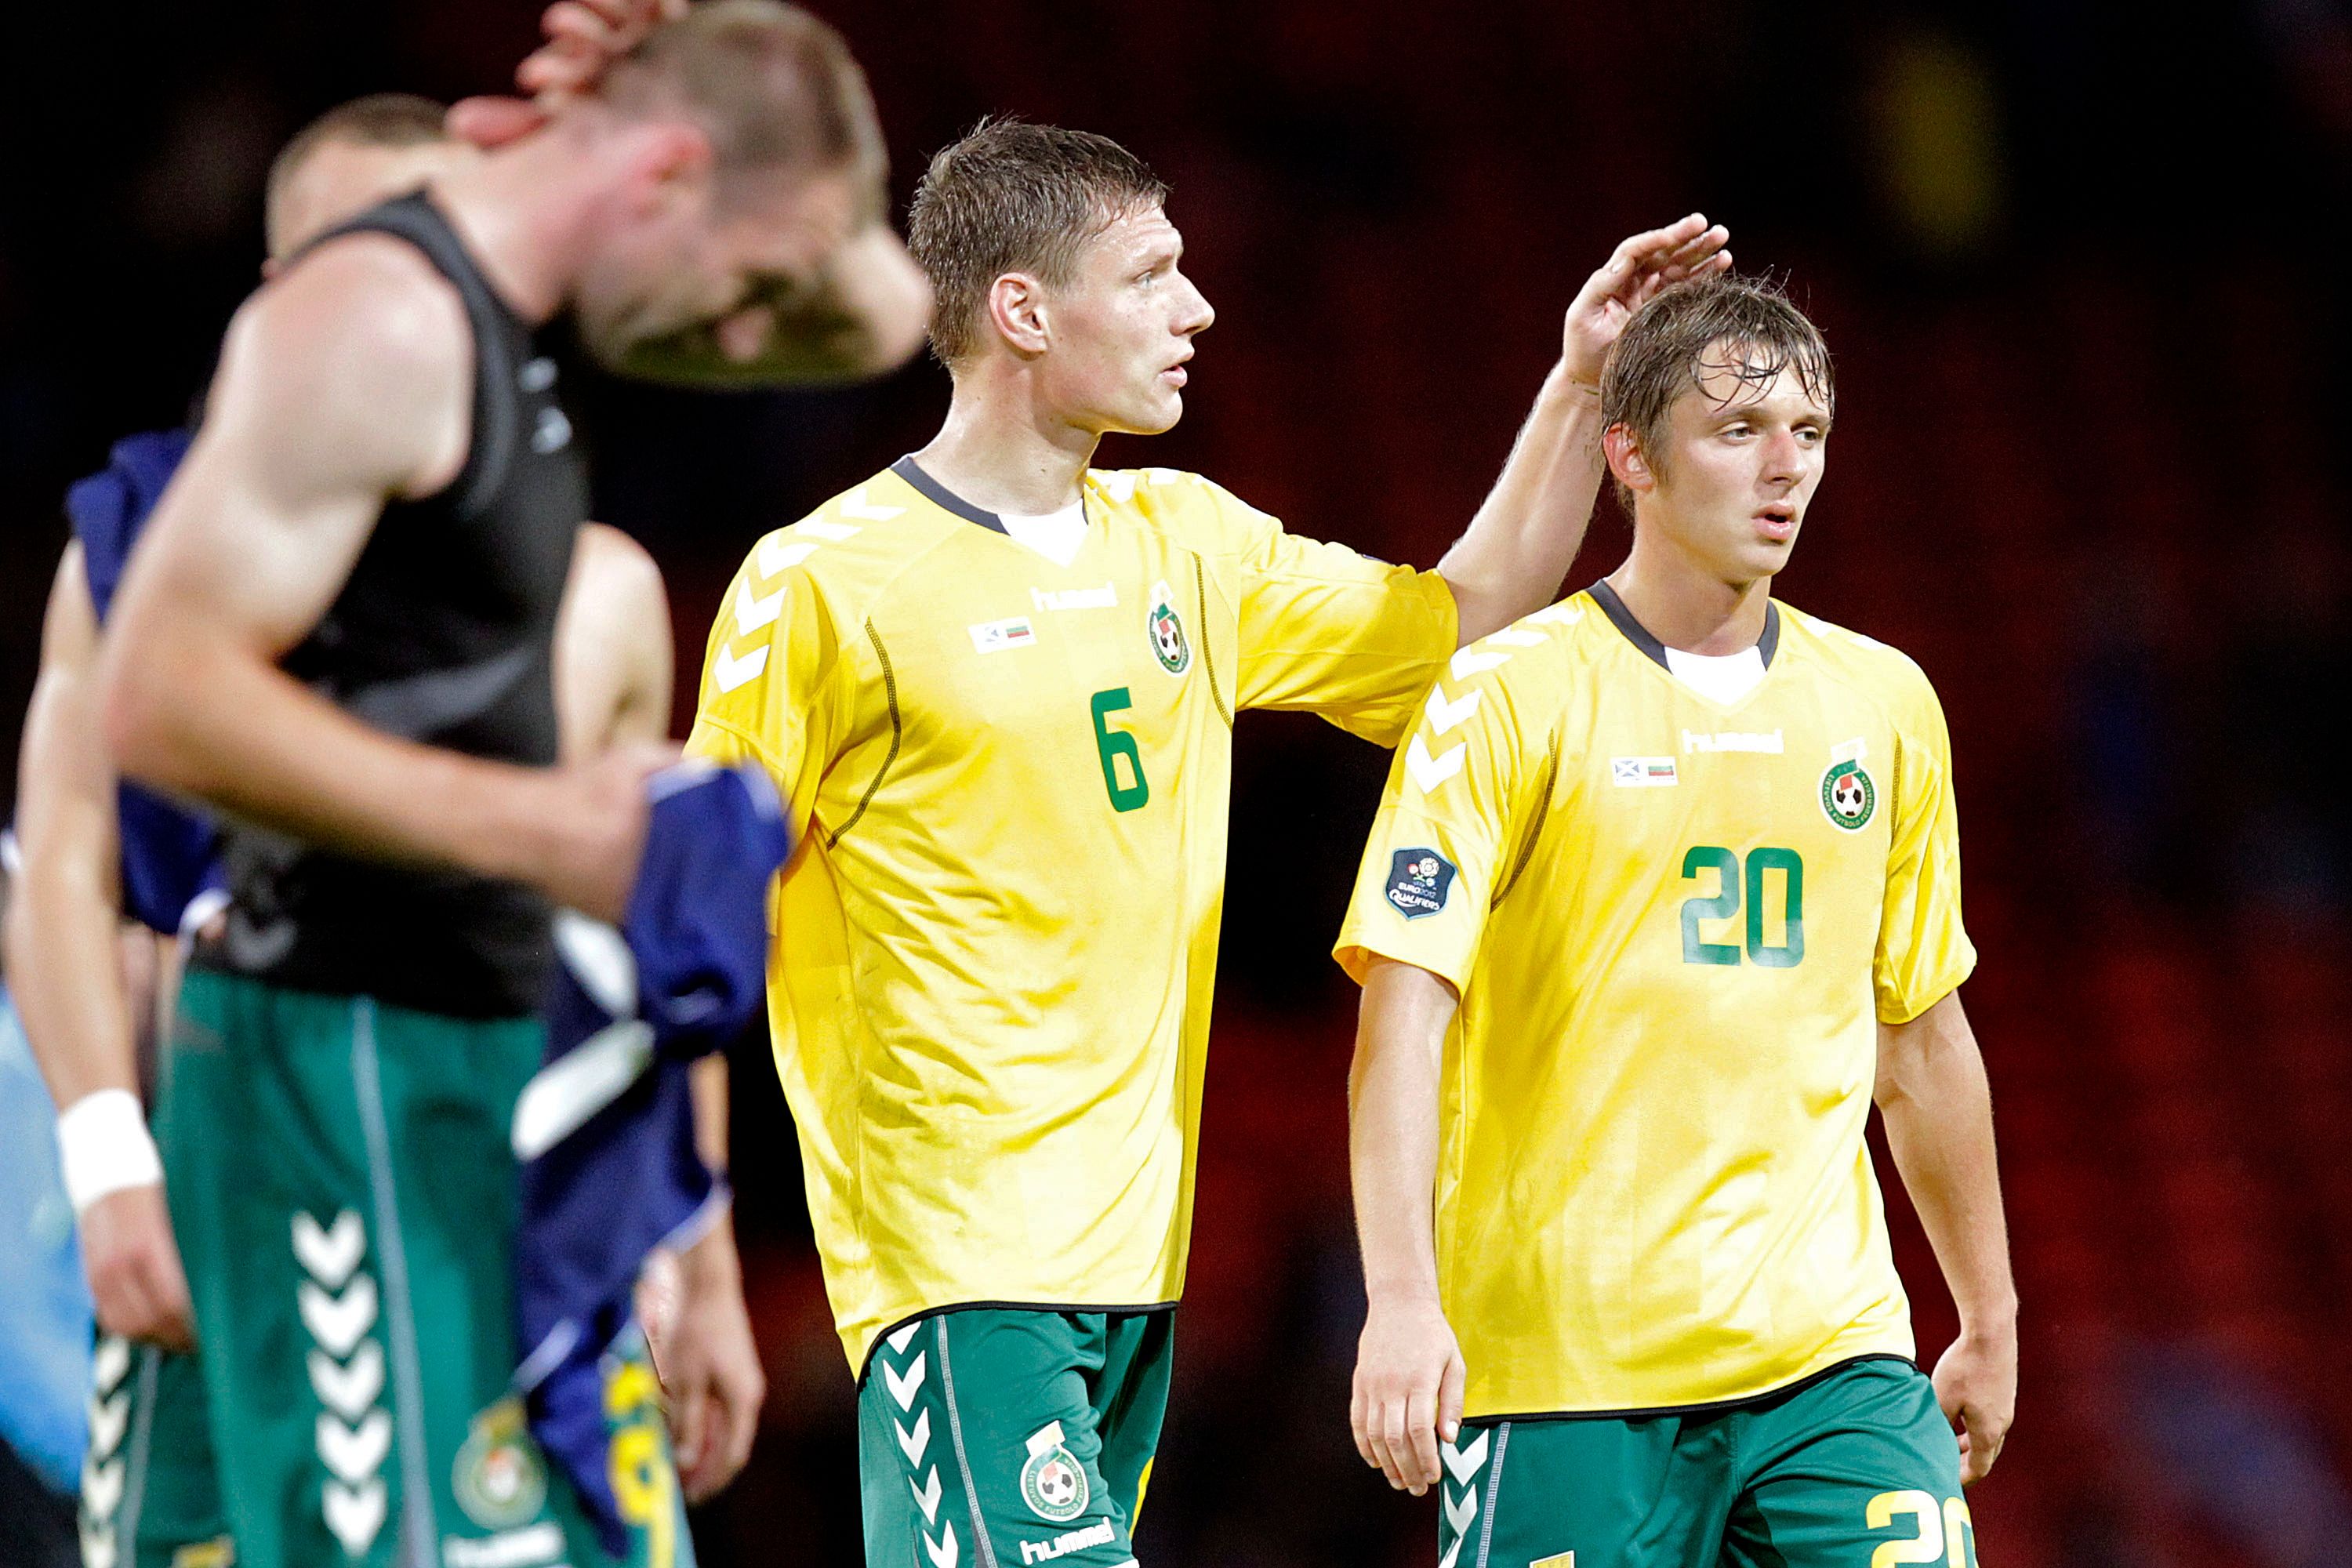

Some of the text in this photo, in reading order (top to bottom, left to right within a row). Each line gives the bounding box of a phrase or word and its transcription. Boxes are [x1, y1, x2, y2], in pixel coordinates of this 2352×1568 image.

[1091, 687, 1149, 812] 6
[1681, 846, 1805, 968] 20
[1021, 1517, 1116, 1565] hummel
